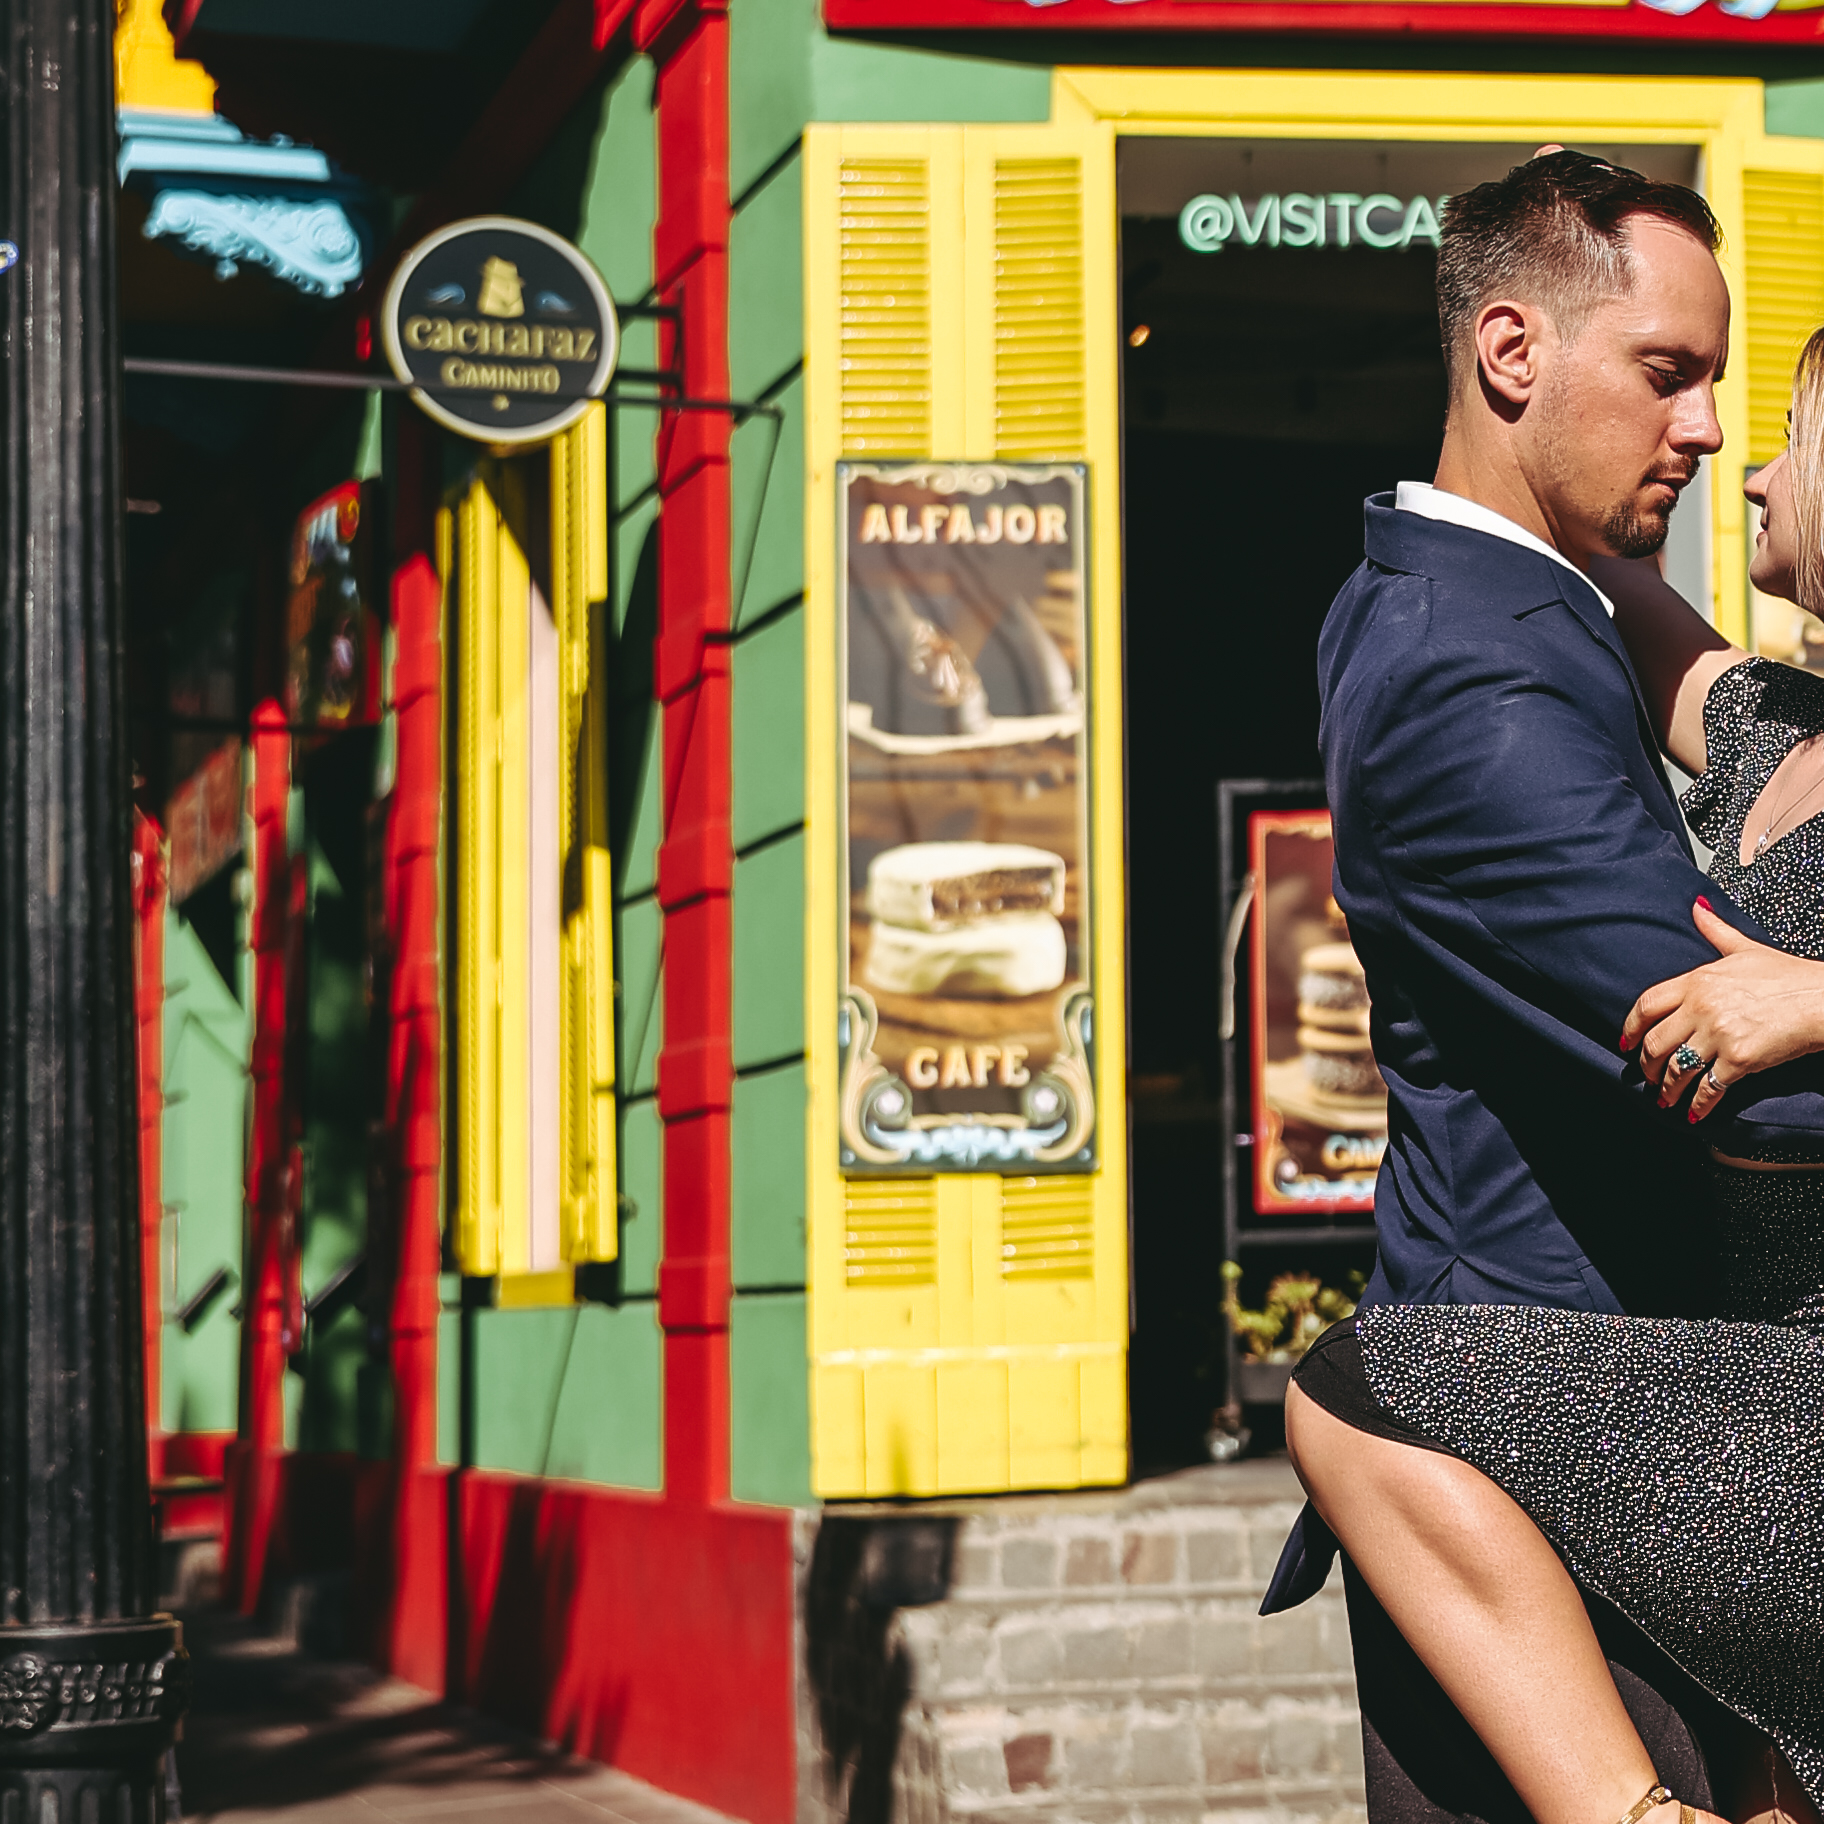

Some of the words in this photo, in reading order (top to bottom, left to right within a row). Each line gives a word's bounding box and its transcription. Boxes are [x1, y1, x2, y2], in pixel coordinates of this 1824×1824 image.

[1178, 193, 1450, 253] @VISITCA
[441, 357, 561, 394] CAMINITO
[859, 503, 1069, 545] ALFAJOR
[905, 1044, 1031, 1089] CAFE
